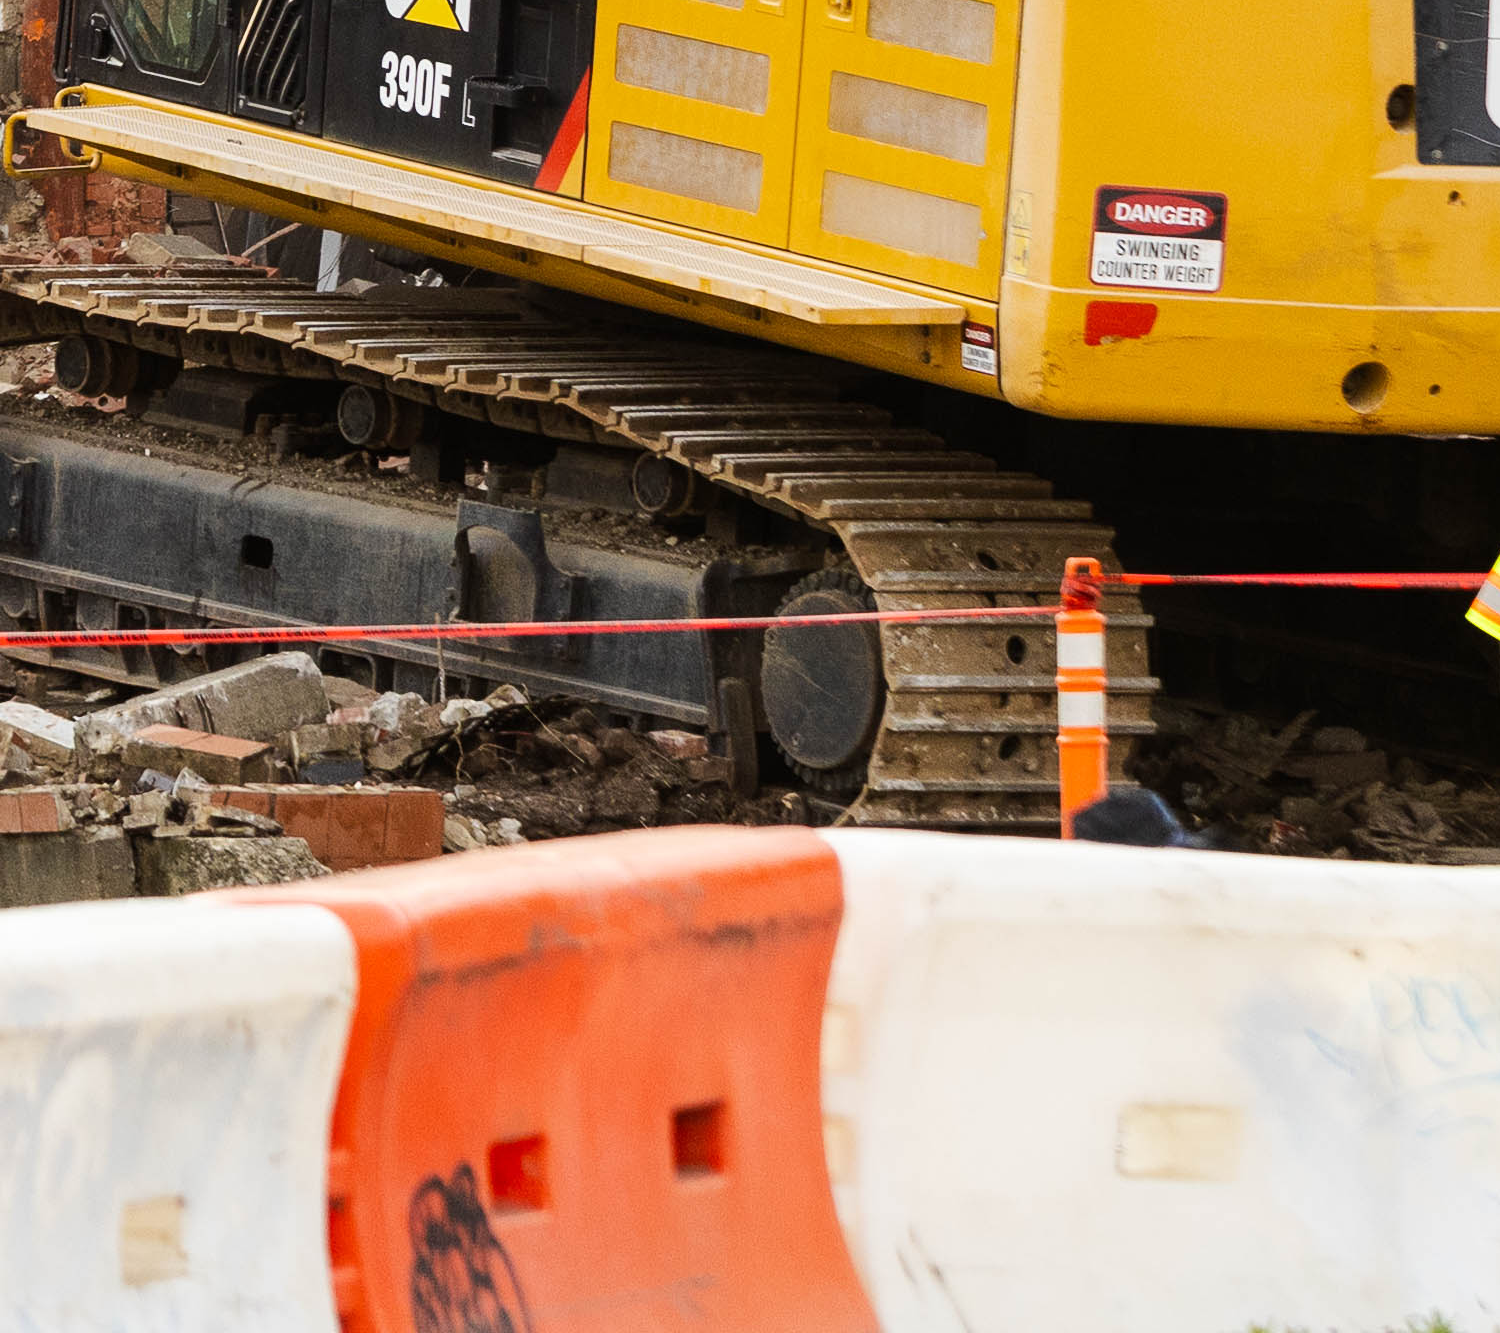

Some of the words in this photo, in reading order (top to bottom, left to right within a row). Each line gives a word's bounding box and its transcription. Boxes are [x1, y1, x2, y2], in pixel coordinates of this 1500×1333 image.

[380, 50, 452, 119] 390F
[462, 79, 475, 128] L
[1114, 202, 1207, 228] DANGER
[1116, 239, 1199, 262] SWINGING
[1096, 260, 1158, 281] COUNTER
[1163, 264, 1215, 284] WEIGHT
